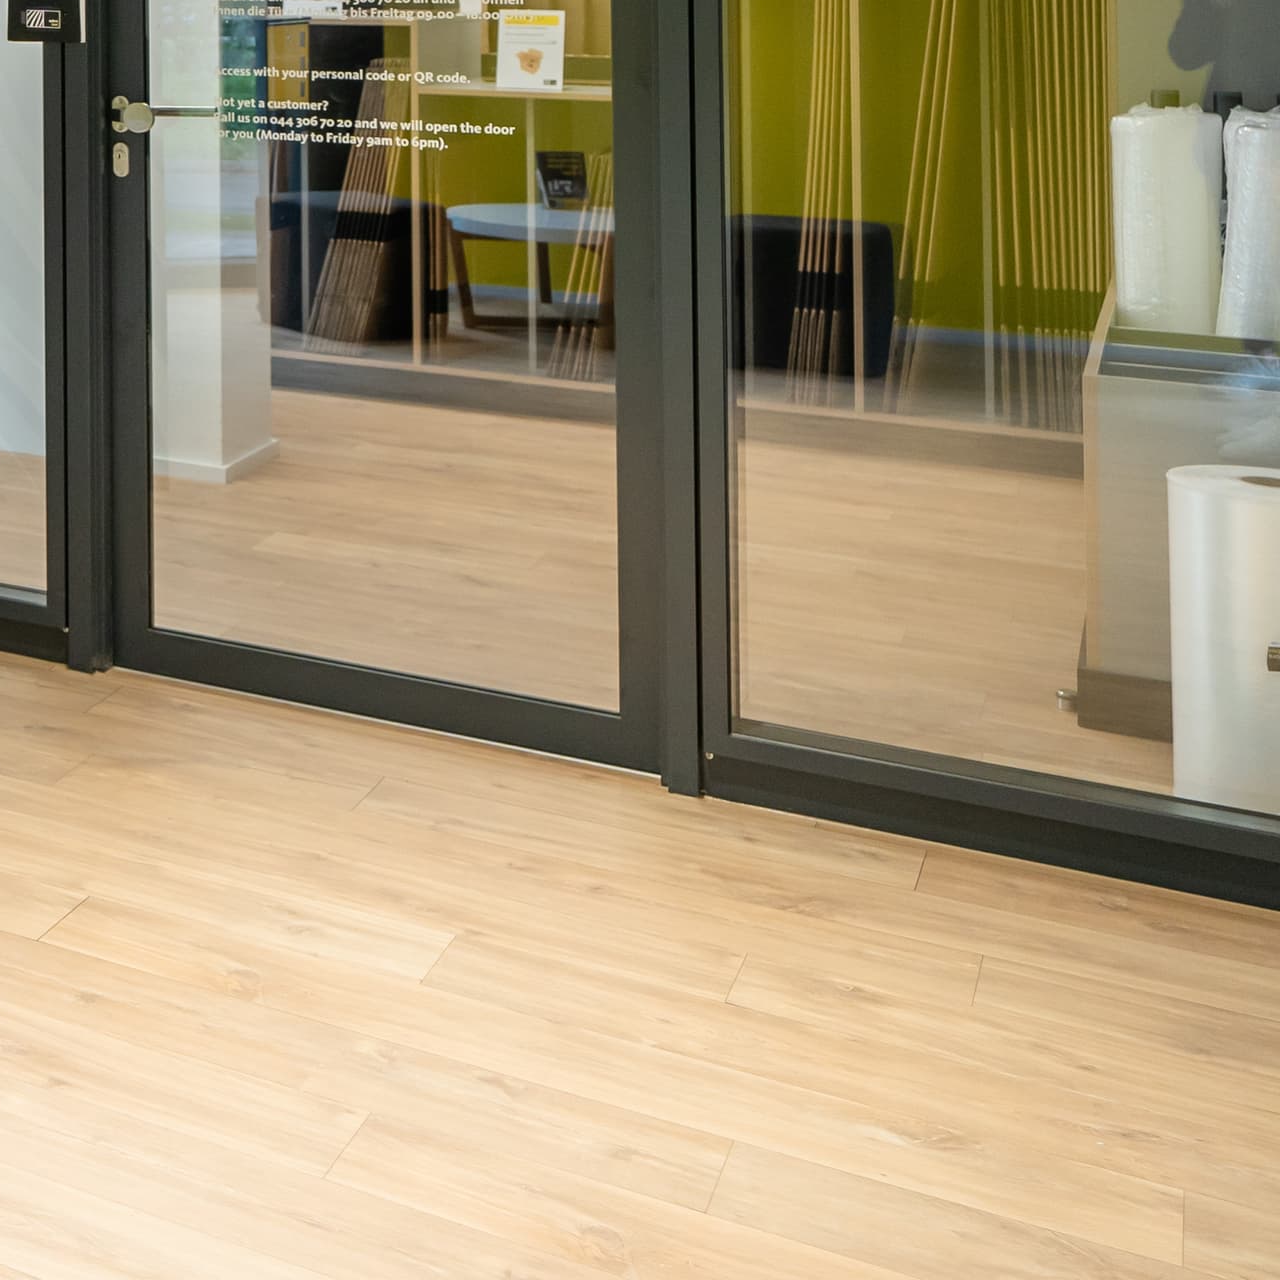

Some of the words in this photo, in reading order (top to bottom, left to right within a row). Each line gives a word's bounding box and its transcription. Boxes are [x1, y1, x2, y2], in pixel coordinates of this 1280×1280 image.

[248, 5, 266, 17] die
[349, 7, 368, 19] bis
[370, 7, 415, 23] Freitag
[253, 66, 279, 78] with
[281, 68, 308, 80] your
[311, 69, 363, 81] personal
[366, 70, 394, 81] code
[397, 72, 410, 82] or
[414, 71, 434, 85] QR
[437, 72, 471, 84] code.
[237, 98, 256, 110] yet
[258, 100, 265, 109] a
[267, 100, 329, 111] customer?
[237, 114, 250, 123] us
[252, 115, 267, 124] on
[269, 116, 294, 128] 044
[296, 116, 318, 127] 306
[320, 118, 334, 129] 70
[337, 118, 352, 128] 20
[354, 118, 377, 129] and
[380, 120, 398, 130] we
[400, 119, 423, 131] will
[425, 122, 457, 134] open
[460, 122, 481, 134] the
[484, 123, 516, 135] door
[215, 128, 229, 138] or
[232, 129, 254, 141] you
[256, 129, 308, 144] (Monday
[310, 132, 324, 143] to
[326, 132, 364, 147] Friday
[366, 137, 392, 148] 9am
[395, 136, 408, 147] to
[411, 136, 449, 151] 6pm).
